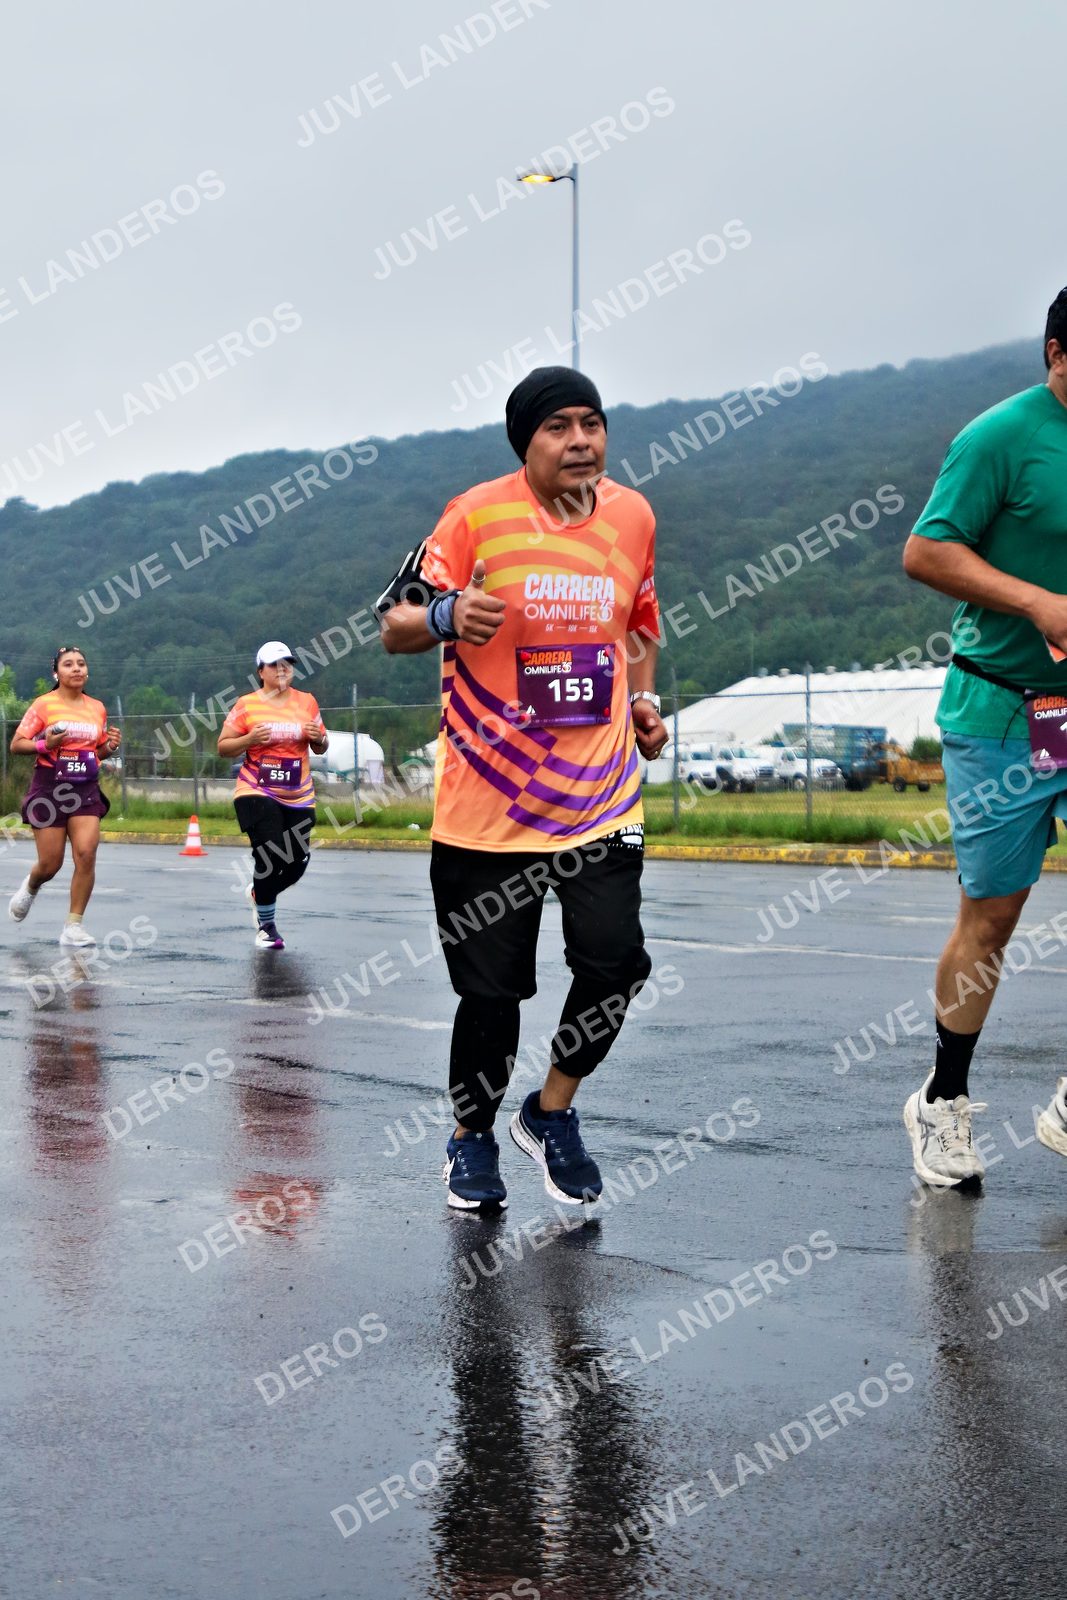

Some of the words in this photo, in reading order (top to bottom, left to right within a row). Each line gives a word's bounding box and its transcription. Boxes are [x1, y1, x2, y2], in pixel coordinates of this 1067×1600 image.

[524, 573, 615, 601] CARRERA
[525, 603, 597, 621] OMNILIFE
[524, 664, 561, 675] OMNILIFE
[548, 678, 594, 703] 153
[67, 761, 87, 772] 554
[270, 769, 291, 781] 551
